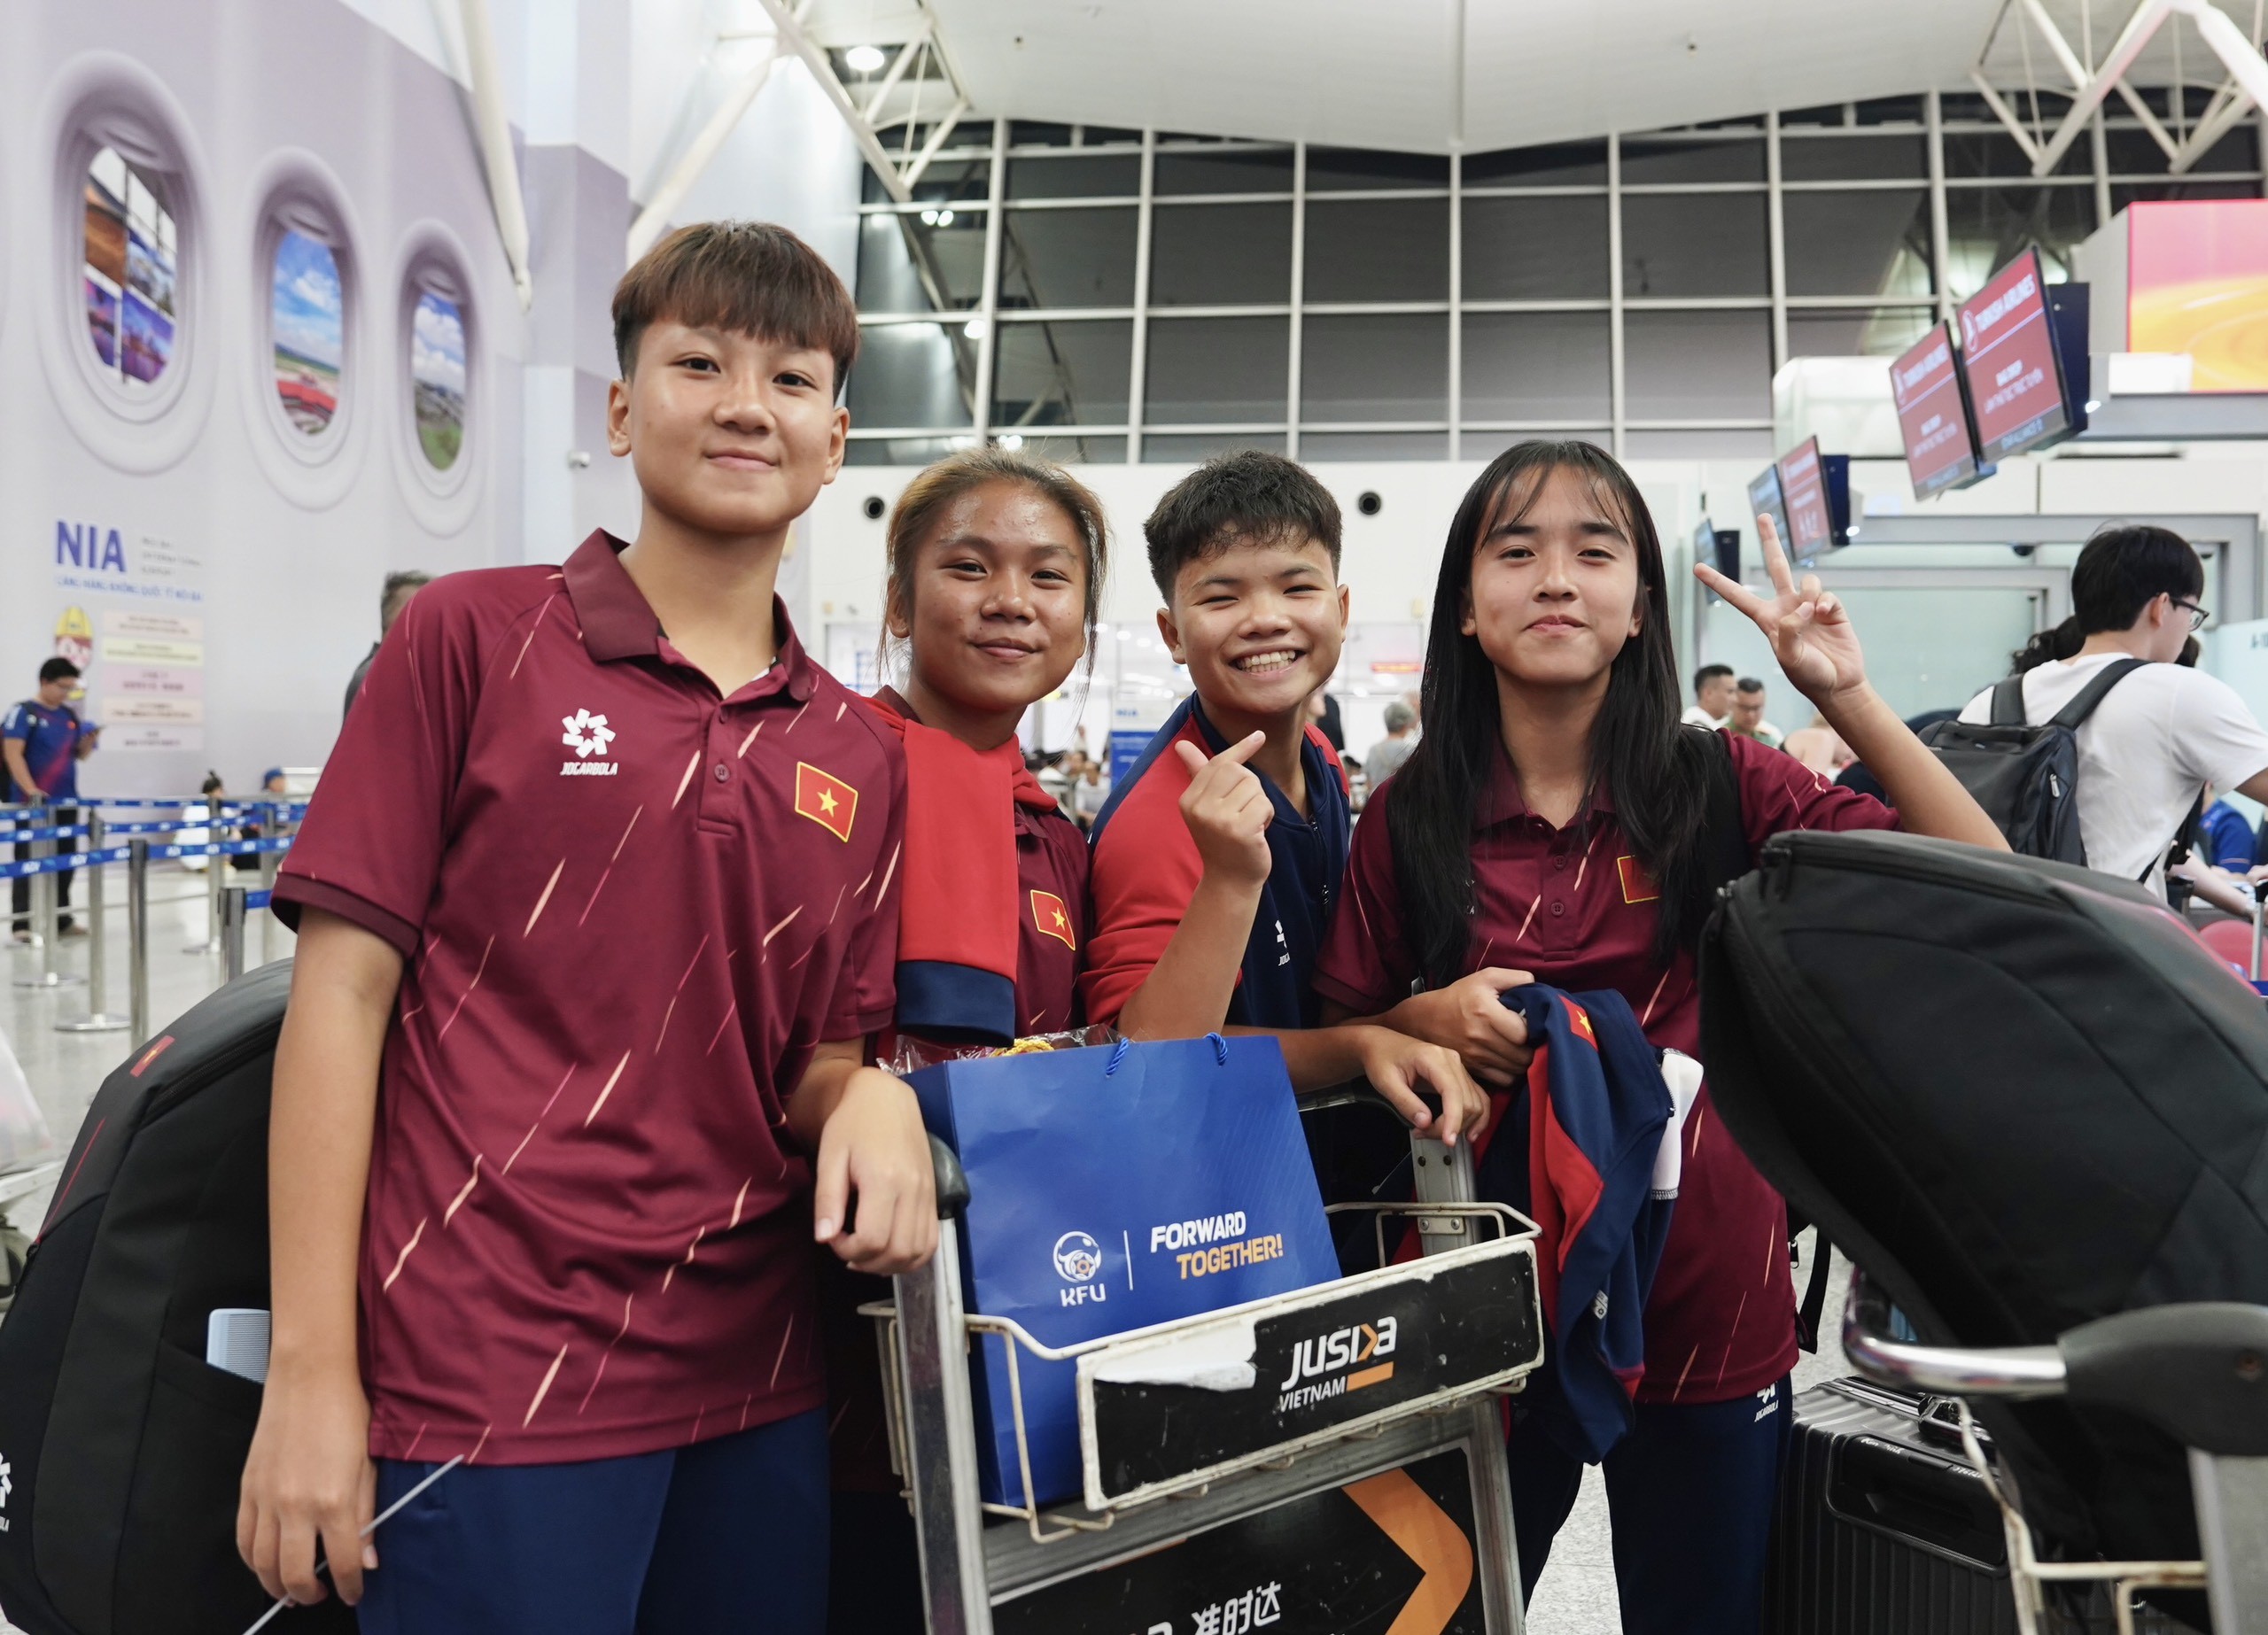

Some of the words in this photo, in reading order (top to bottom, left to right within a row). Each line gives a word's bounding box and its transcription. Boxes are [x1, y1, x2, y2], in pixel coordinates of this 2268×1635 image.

[57, 520, 127, 572] NIA
[560, 762, 618, 776] JOGARBOLA
[1150, 1210, 1247, 1253] FORWARD
[1176, 1233, 1284, 1281] TOGETHER!
[1060, 1282, 1107, 1307] KFU
[1278, 1375, 1347, 1414] VIETNAM
